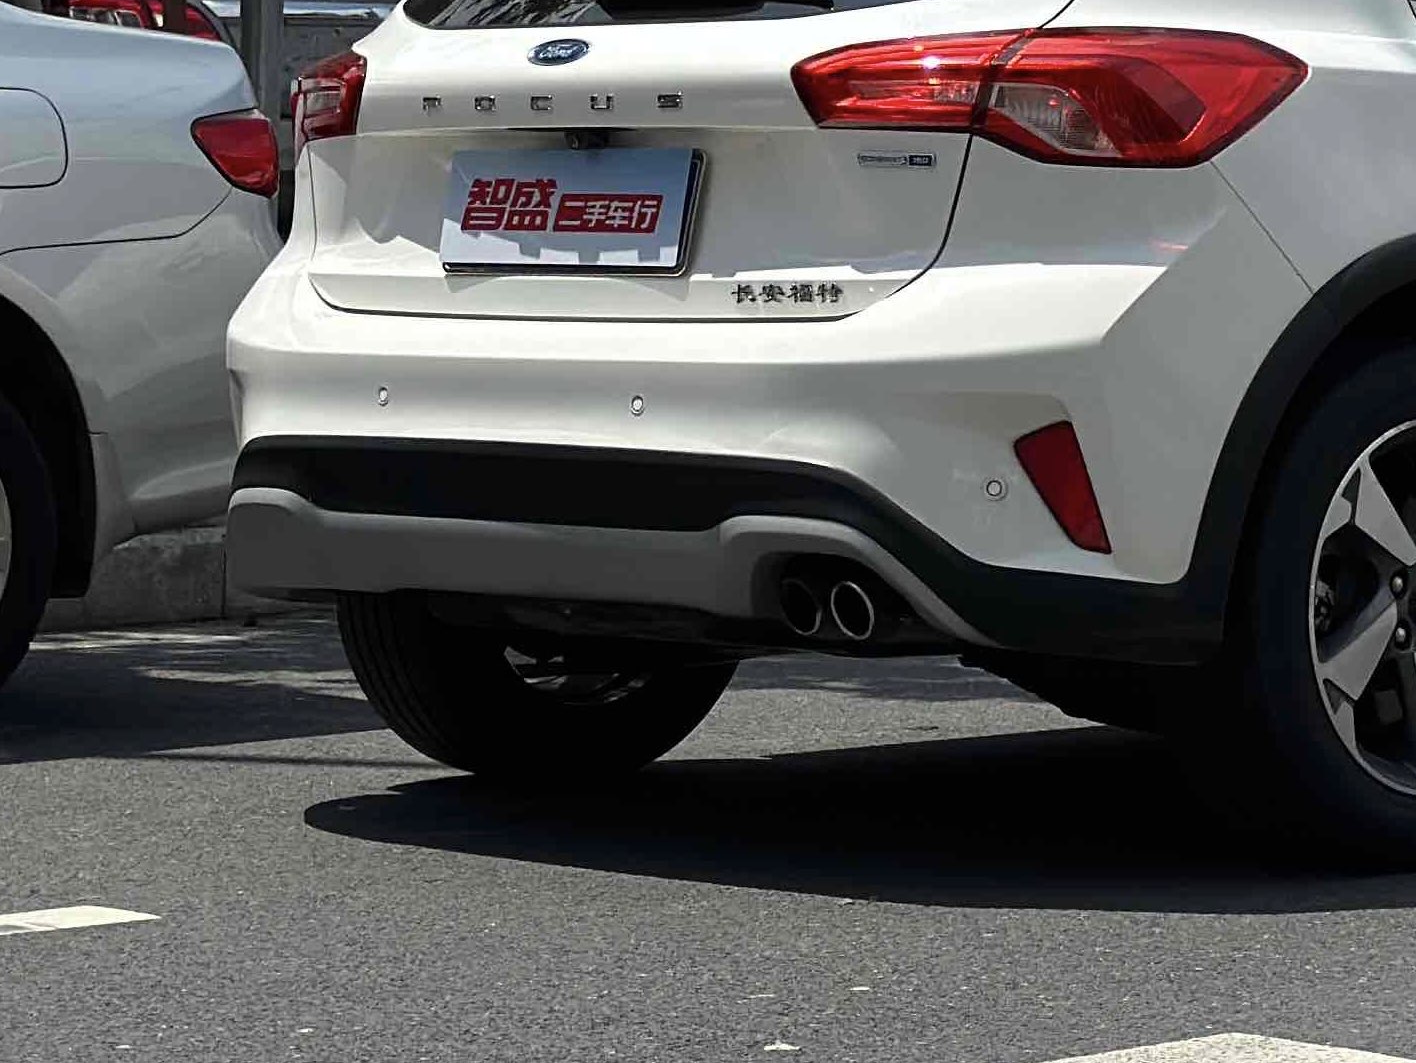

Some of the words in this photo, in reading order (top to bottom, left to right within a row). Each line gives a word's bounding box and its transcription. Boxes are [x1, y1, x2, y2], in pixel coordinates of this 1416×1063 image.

[422, 90, 683, 112] FOCUS
[461, 178, 559, 231] 智盛
[559, 199, 659, 229] 二手车行
[731, 281, 844, 304] 长安福特
